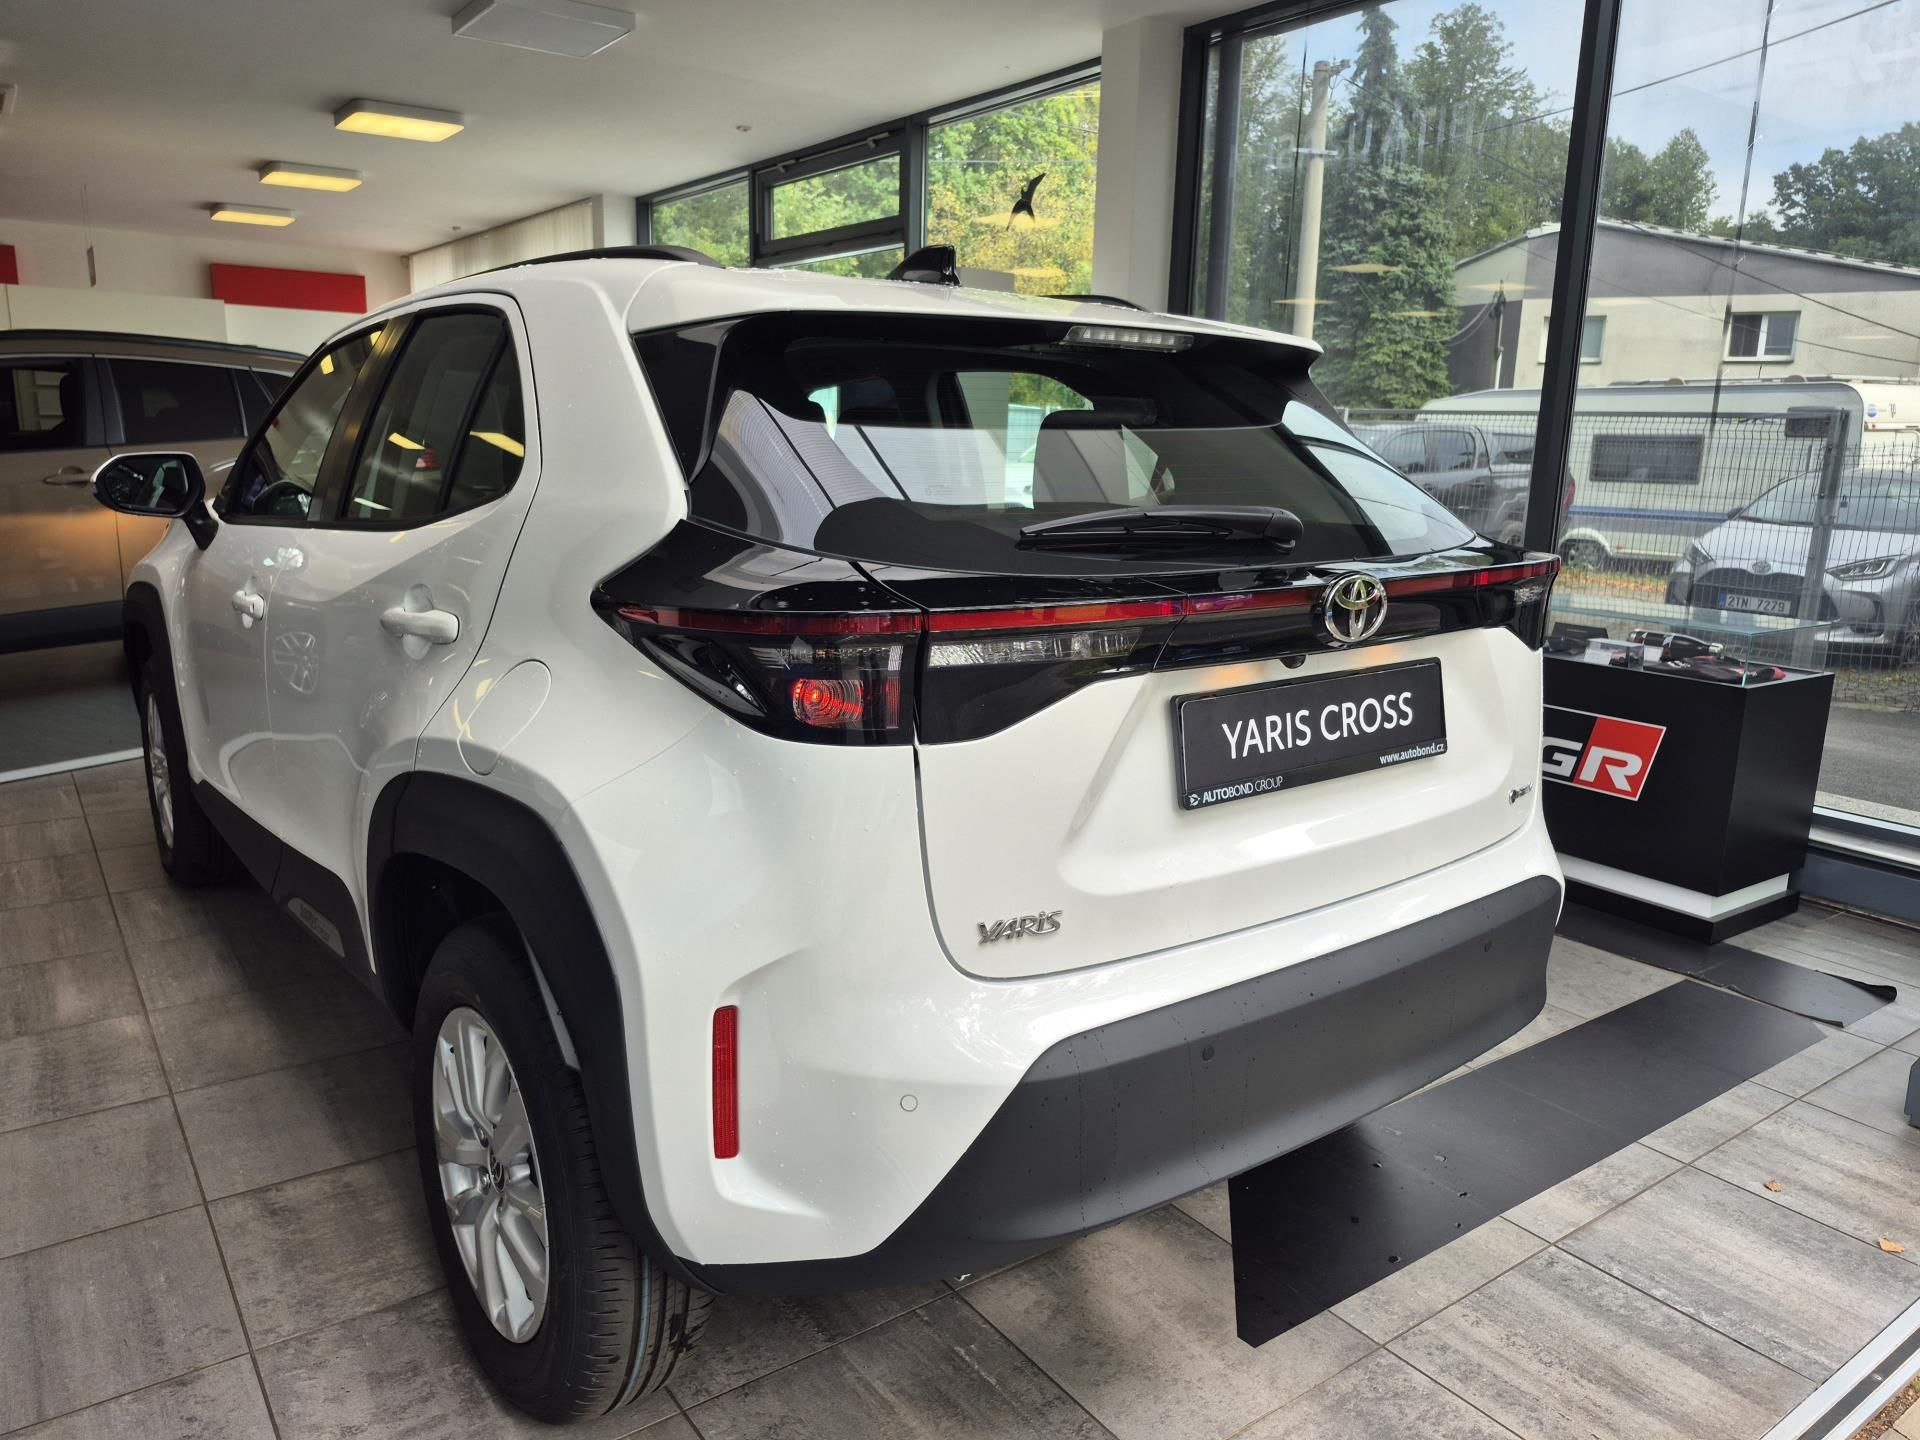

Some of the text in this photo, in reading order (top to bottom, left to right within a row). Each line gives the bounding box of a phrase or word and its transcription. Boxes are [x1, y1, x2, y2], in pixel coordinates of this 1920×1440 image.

[1757, 599, 1785, 612] 7279
[1222, 692, 1413, 760] YARIS CROSS
[1379, 743, 1444, 765] www.autobond.cz
[1543, 737, 1642, 792] GR
[1203, 776, 1283, 803] AUTOBOND GROUP
